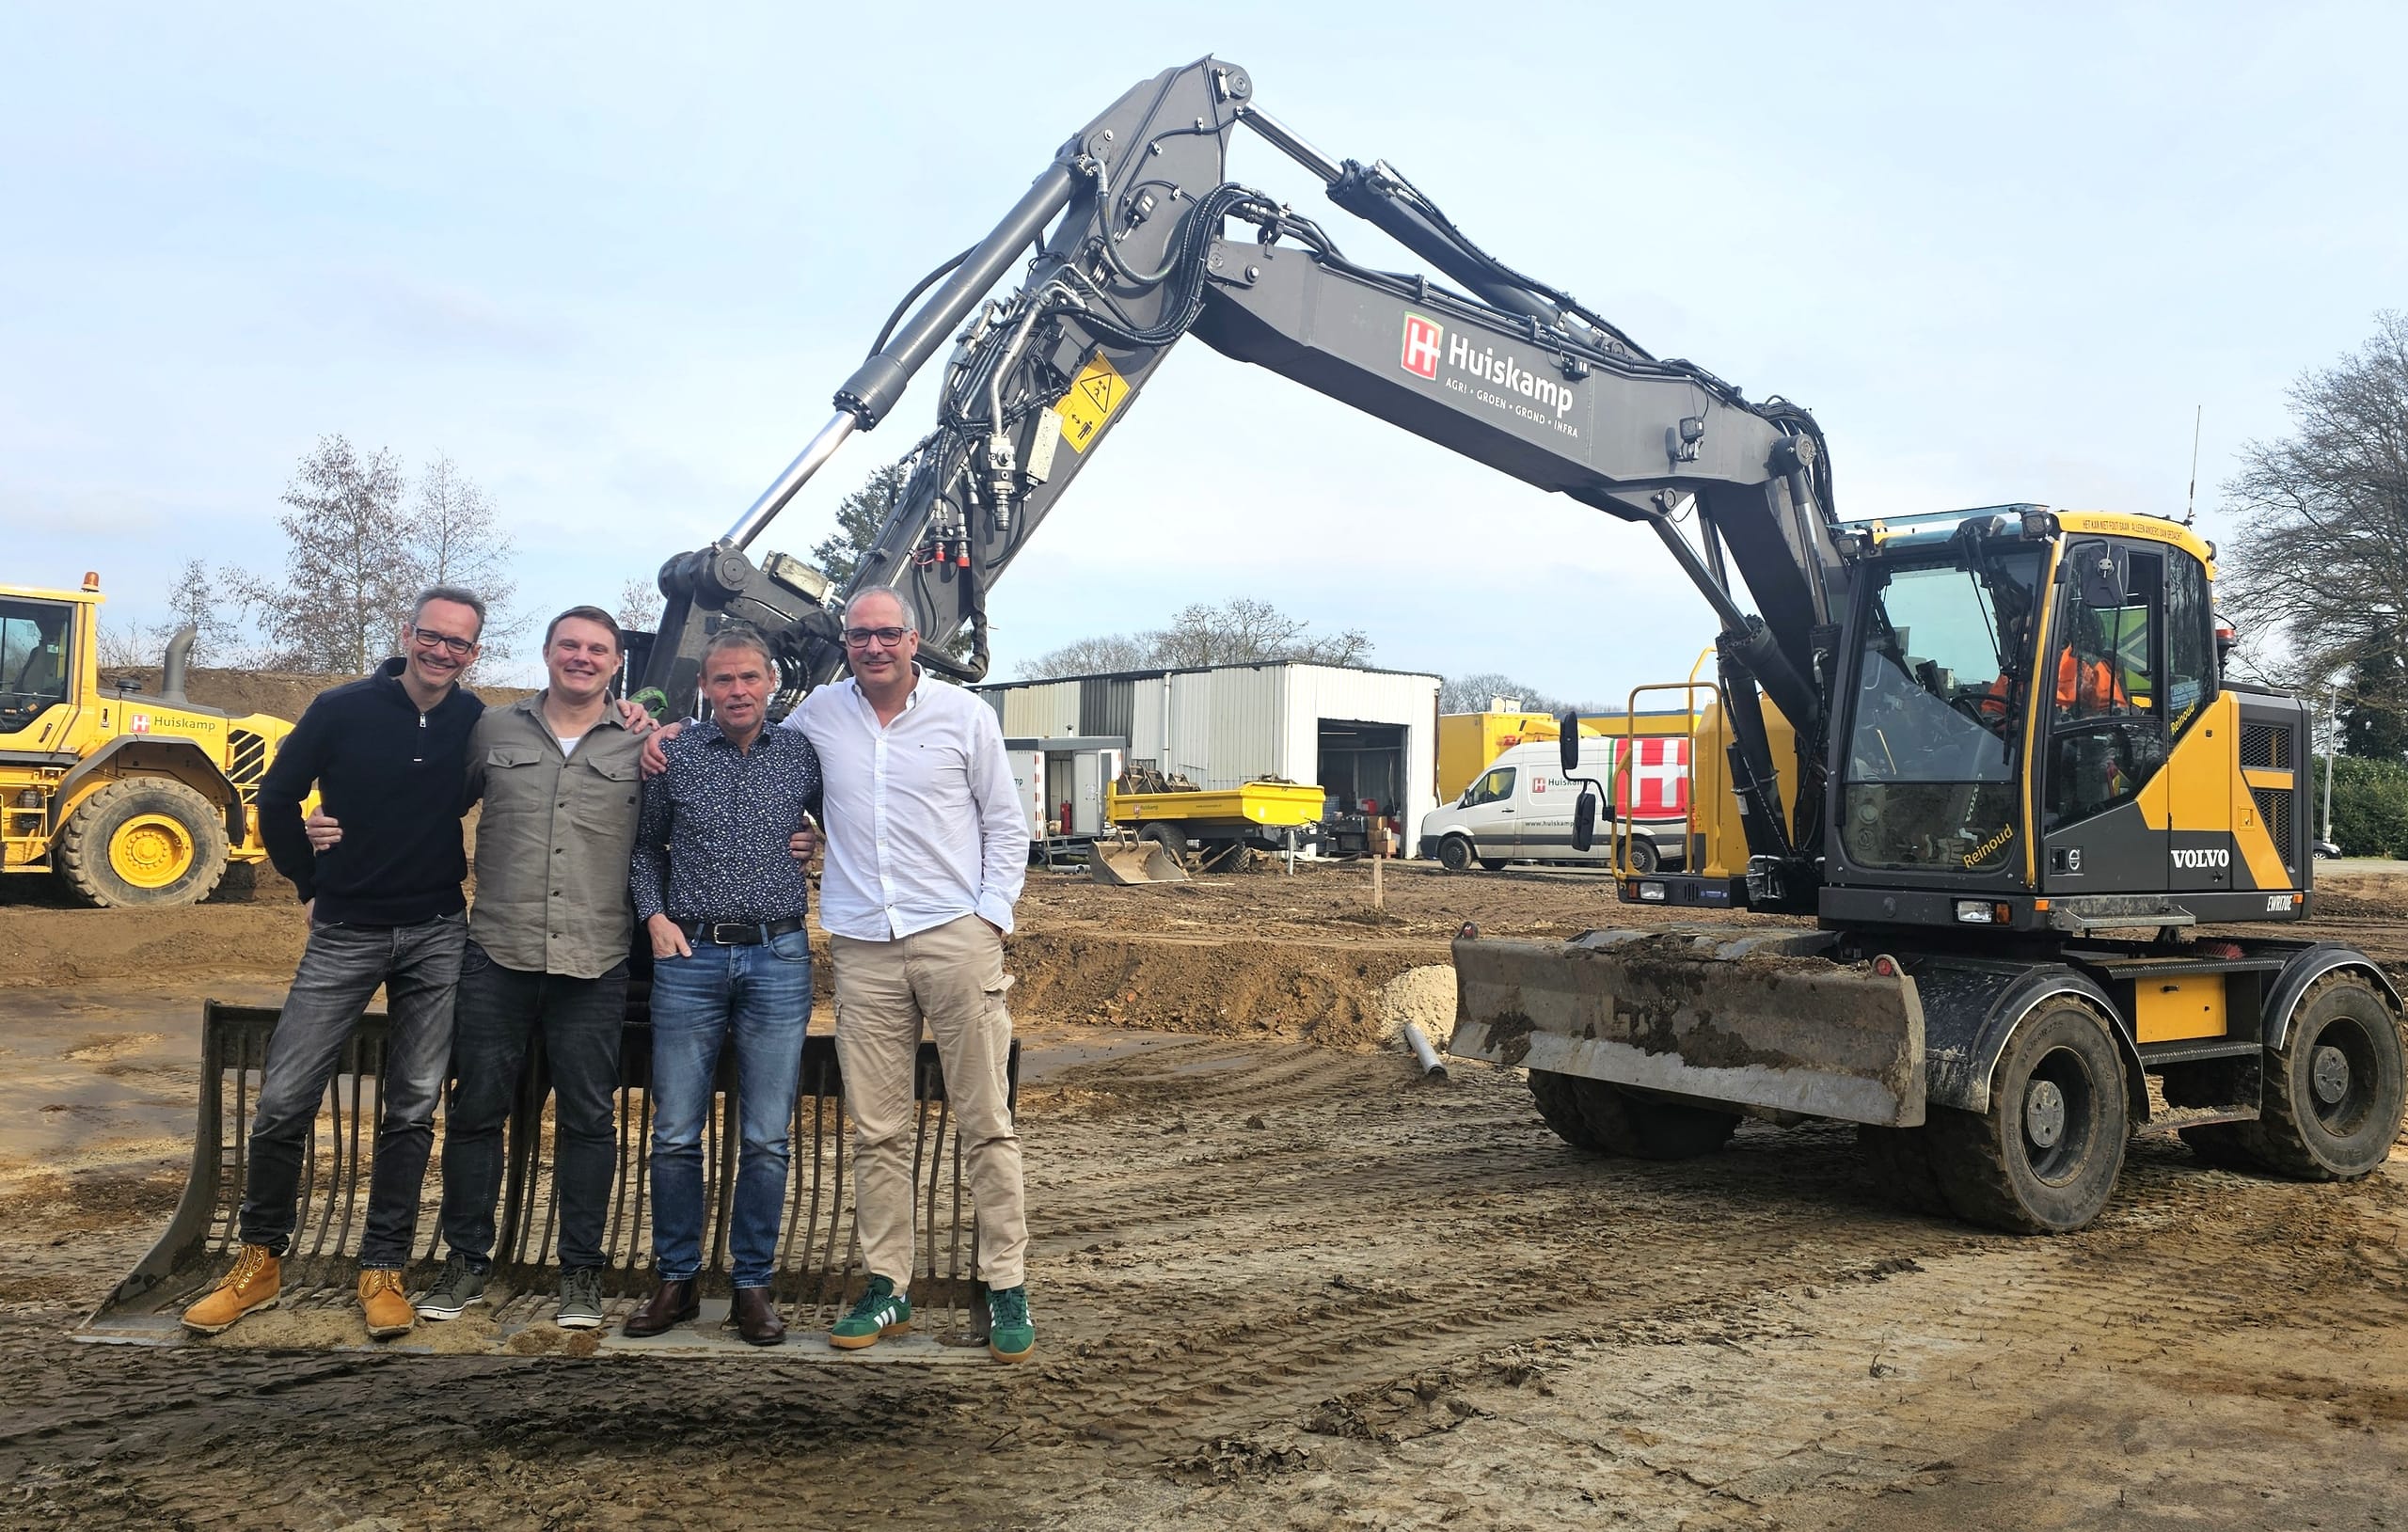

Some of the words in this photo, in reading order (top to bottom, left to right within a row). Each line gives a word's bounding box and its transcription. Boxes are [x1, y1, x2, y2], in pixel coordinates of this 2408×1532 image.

[1449, 333, 1574, 419] Huiskamp
[1445, 377, 1467, 394] AGRI
[1476, 389, 1507, 410] GROEN
[1515, 404, 1545, 424] GROND
[1554, 419, 1578, 438] INFRA
[154, 716, 215, 733] Huiskamp
[2170, 699, 2194, 736] Reinoud
[1962, 823, 2013, 868] Reinoud
[2170, 849, 2230, 868] VOLVO
[2266, 894, 2293, 912] EWR170E
